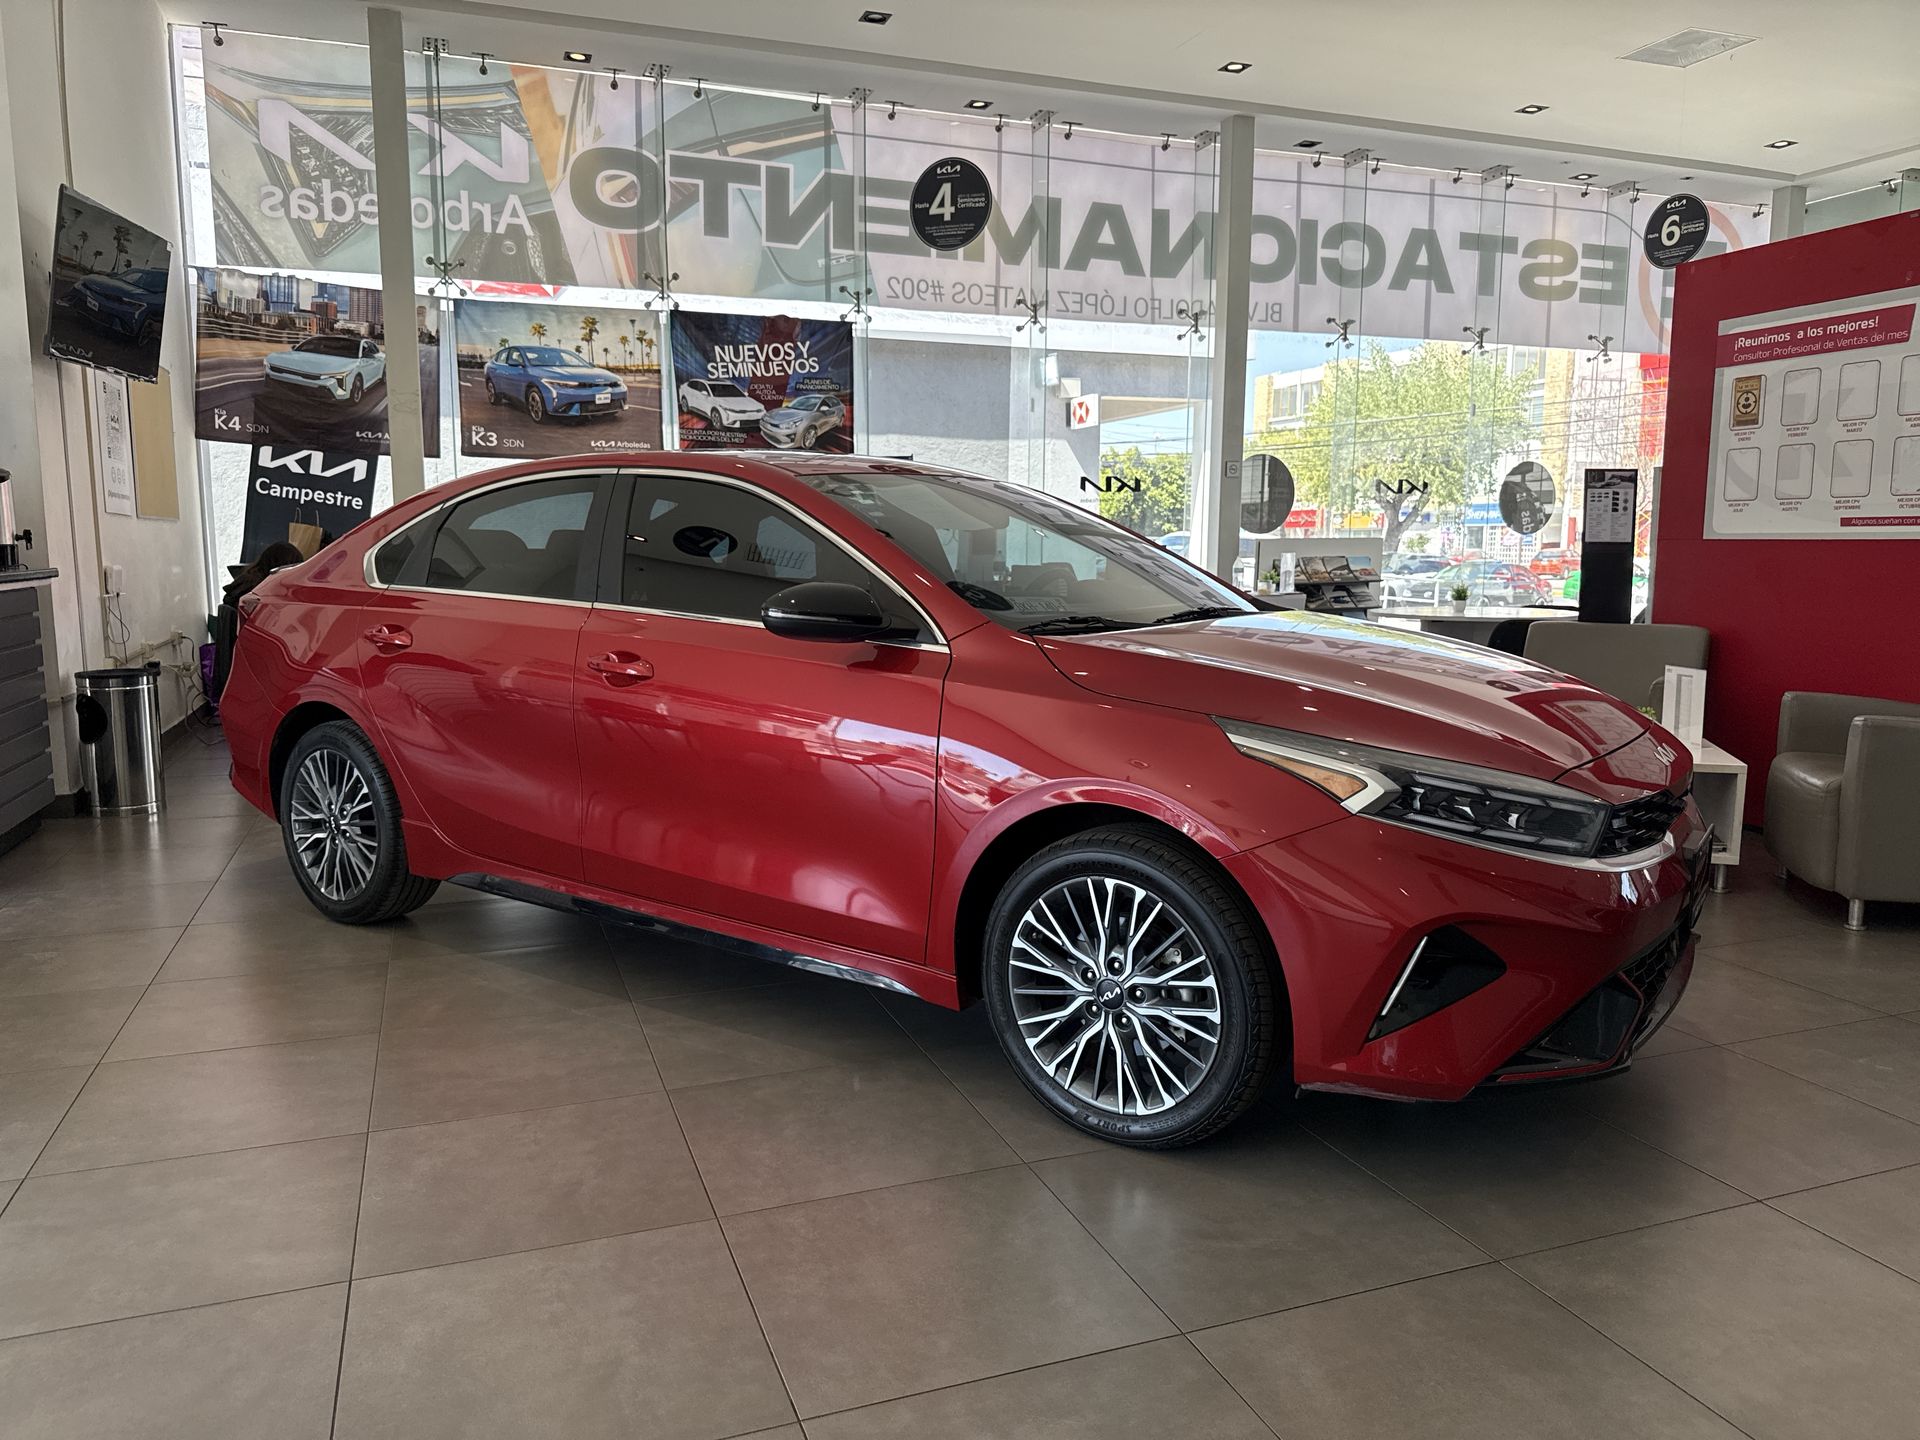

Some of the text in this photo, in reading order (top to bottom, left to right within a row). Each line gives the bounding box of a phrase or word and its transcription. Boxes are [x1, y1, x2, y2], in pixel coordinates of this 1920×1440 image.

[936, 164, 961, 174] KIA
[928, 182, 956, 222] 4
[1666, 199, 1687, 210] KIA
[1660, 214, 1682, 248] 6
[1734, 315, 1880, 351] ¡Reunimos a los mejores!
[714, 340, 811, 364] NUEVOS Y
[1733, 329, 1909, 362] Consultor Profesional de Ventas del mes
[707, 357, 820, 380] SEMINUEVOS
[214, 407, 226, 416] Kia
[214, 414, 270, 434] K4 SDN
[355, 430, 382, 439] KIA
[472, 431, 498, 446] K3
[503, 438, 525, 448] SDN
[616, 441, 651, 449] Arboledas
[257, 446, 368, 483] KIA
[255, 477, 364, 510] Campestre
[1851, 517, 1877, 527] Algunos
[1878, 517, 1903, 525] sueñan
[1099, 987, 1121, 1003] KIA
